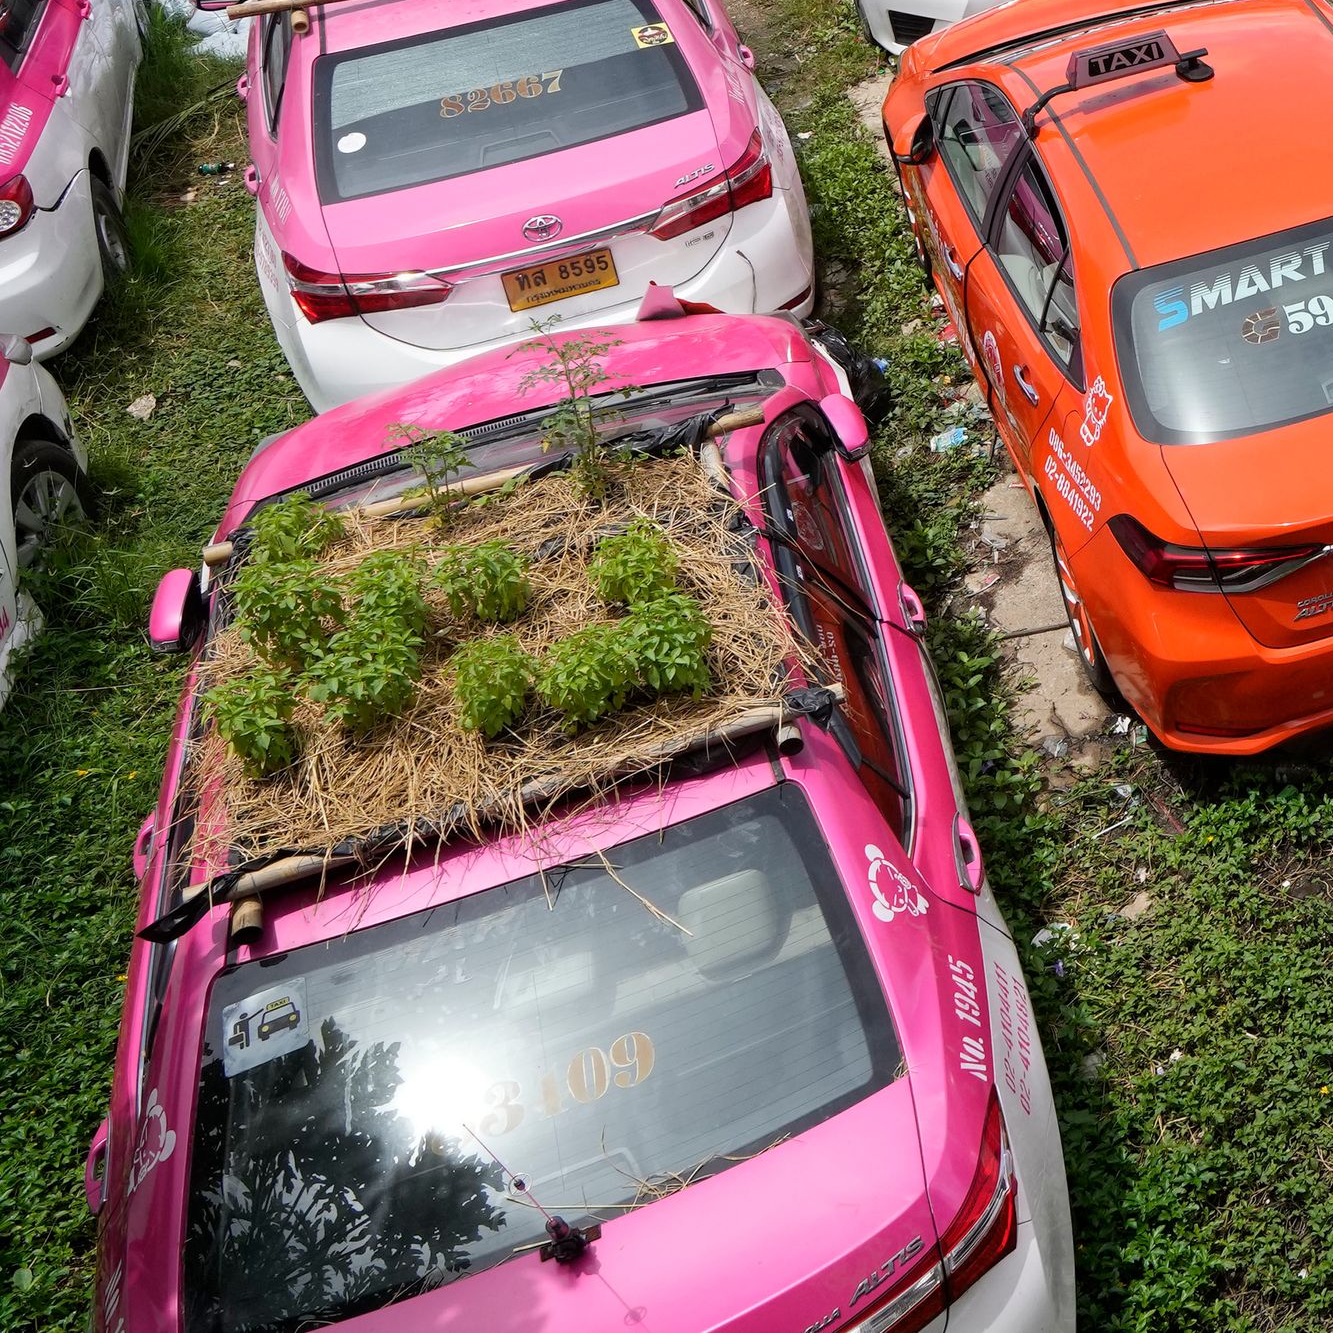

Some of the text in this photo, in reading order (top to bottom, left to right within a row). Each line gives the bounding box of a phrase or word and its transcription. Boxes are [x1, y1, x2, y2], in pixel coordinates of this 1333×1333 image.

[439, 68, 565, 119] 82667
[1093, 40, 1162, 74] TAXI
[674, 161, 716, 190] ALTIS
[559, 254, 610, 281] 8595
[1153, 240, 1332, 332] SMART
[1044, 453, 1094, 532] 02-8841922
[1048, 427, 1102, 512] 086-3452293
[268, 997, 291, 1012] TAXI
[953, 955, 988, 1081] No. 1945
[993, 961, 1018, 1094] 02-4104411
[1012, 977, 1032, 1117] 02-4104821
[849, 1233, 926, 1308] ALTIS
